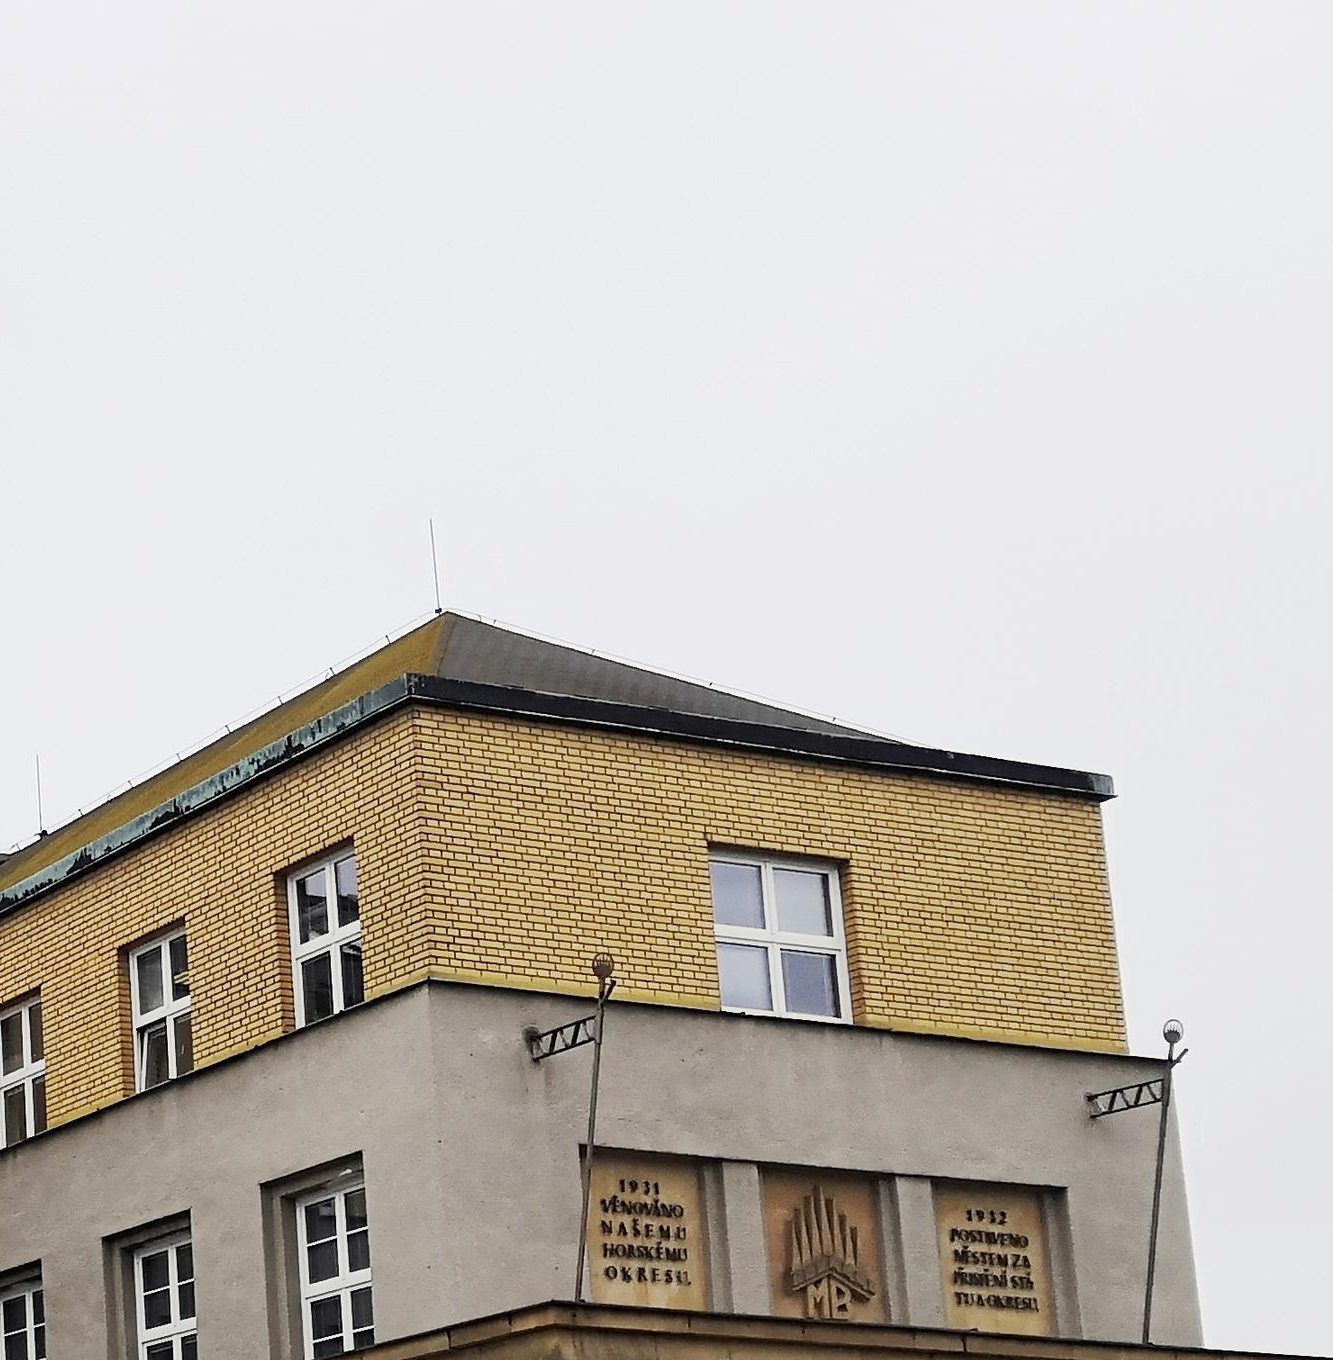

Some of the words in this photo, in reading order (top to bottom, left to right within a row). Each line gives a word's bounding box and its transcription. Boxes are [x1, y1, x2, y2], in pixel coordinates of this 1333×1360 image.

[619, 1179, 660, 1195] 1931
[600, 1218, 687, 1240] NAŠEMU
[602, 1241, 688, 1262] HORSKÉMU
[1011, 1253, 1032, 1269] ZA
